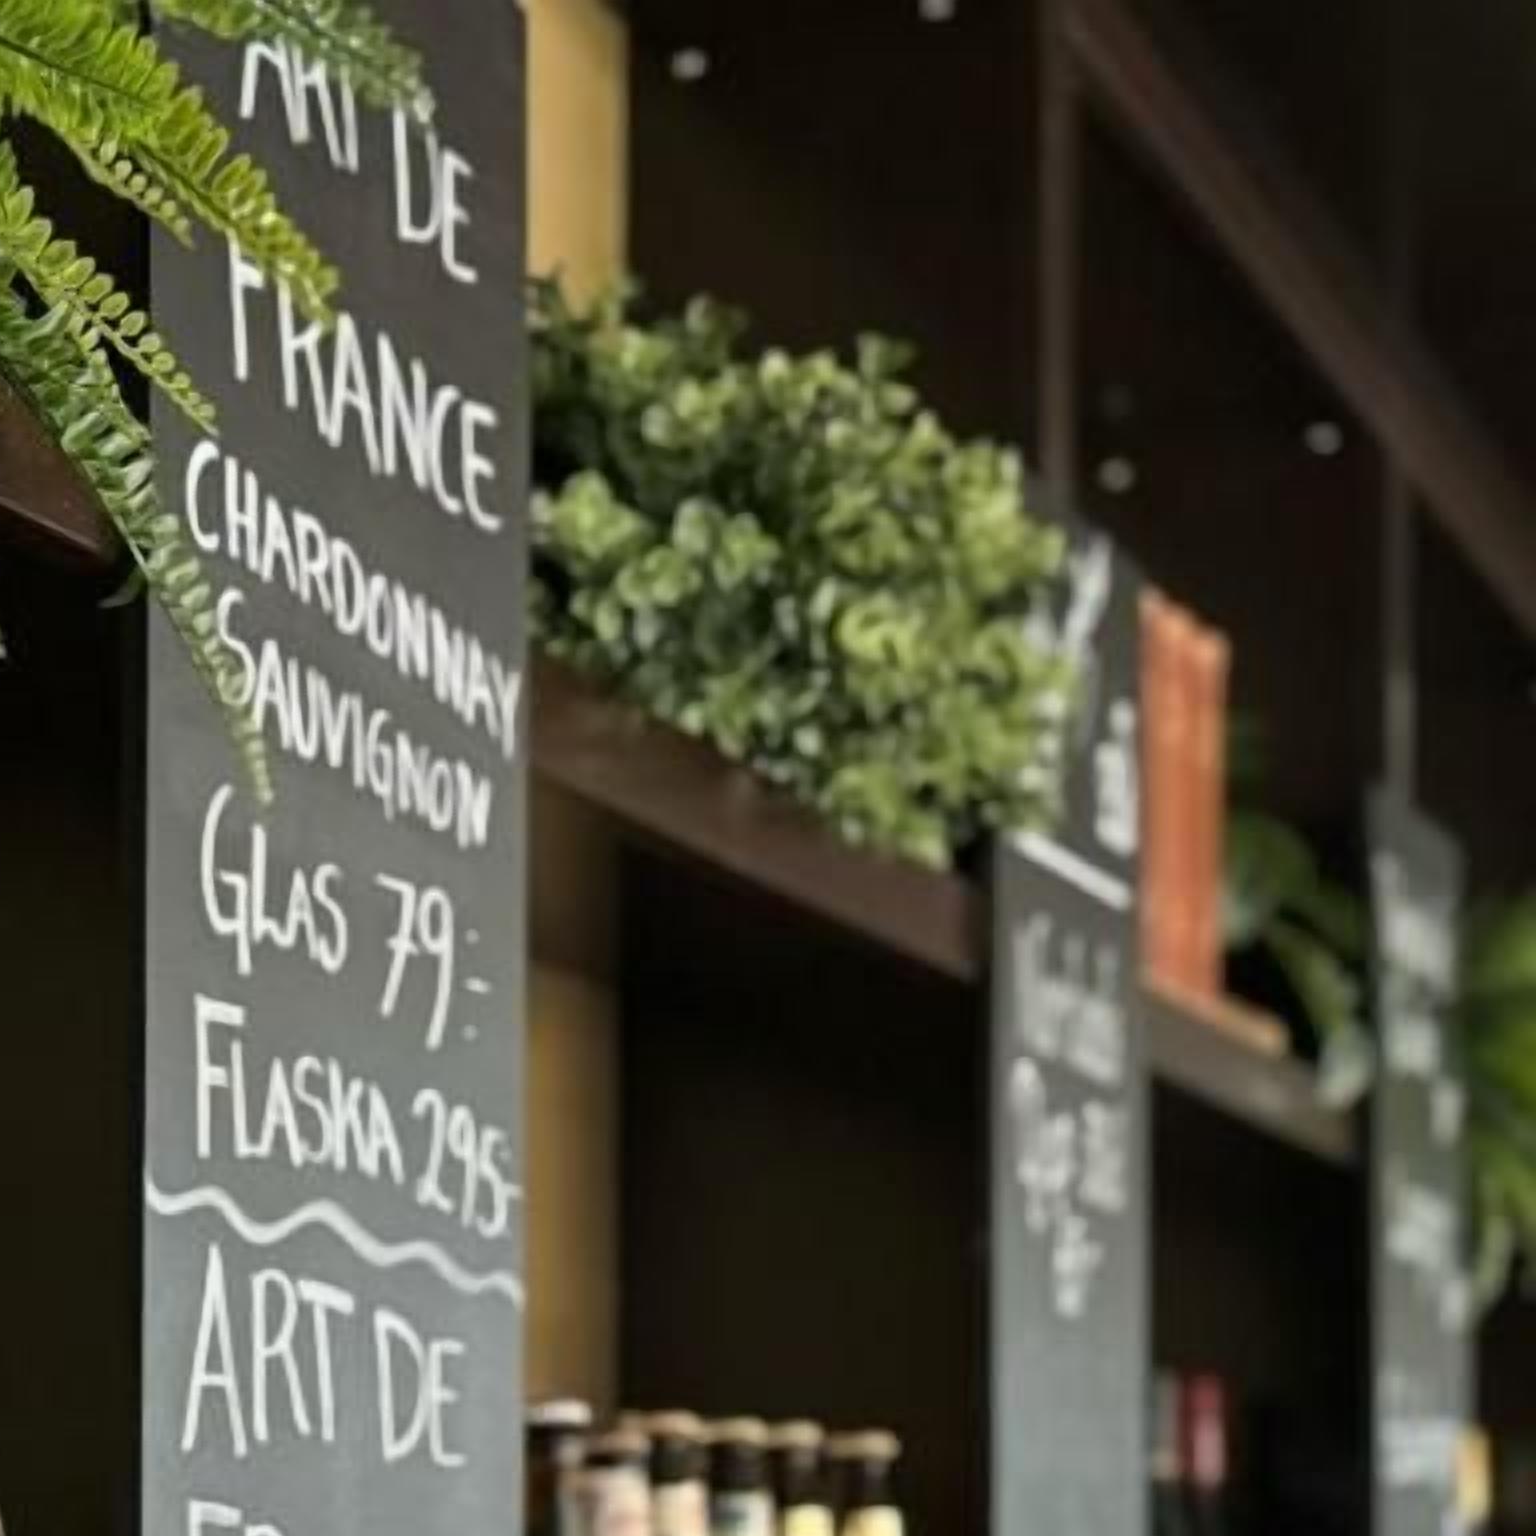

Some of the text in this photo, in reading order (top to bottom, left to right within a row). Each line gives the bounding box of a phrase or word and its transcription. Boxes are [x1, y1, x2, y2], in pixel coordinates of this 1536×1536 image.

[391, 106, 479, 285] DE
[227, 228, 504, 533] FRANCE
[185, 439, 522, 760] CHARDONNAY
[216, 587, 493, 851] SAUVIGNON
[193, 992, 405, 1185] FLASKA
[180, 1242, 468, 1468] ART DE
